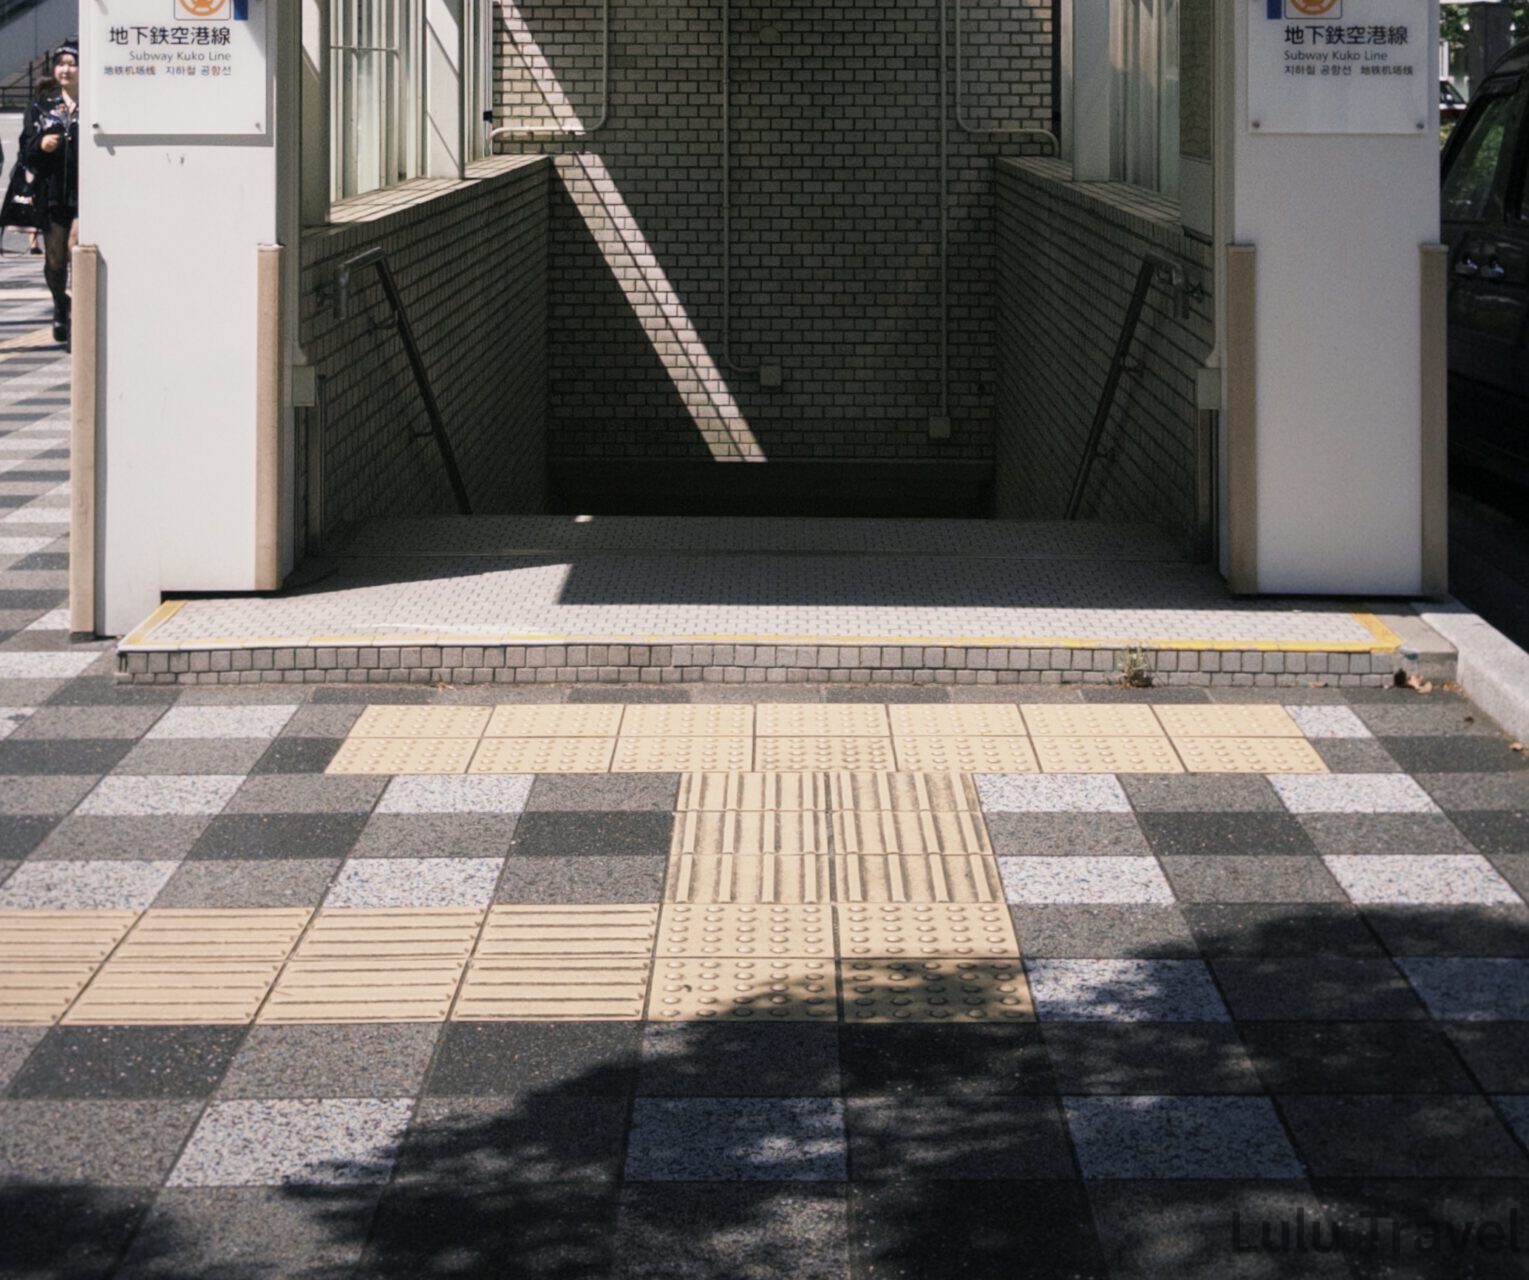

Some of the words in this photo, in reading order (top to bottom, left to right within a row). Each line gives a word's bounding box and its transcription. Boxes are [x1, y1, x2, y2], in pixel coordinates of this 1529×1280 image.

[109, 26, 231, 46] 地下鉄空港線
[1284, 25, 1409, 45] 地下鉄空港線
[129, 50, 174, 63] Subway
[176, 50, 205, 62] Kuko
[208, 50, 232, 62] Line
[1283, 49, 1329, 63] Subway
[1332, 50, 1361, 61] Kuko
[1364, 50, 1389, 61] Line
